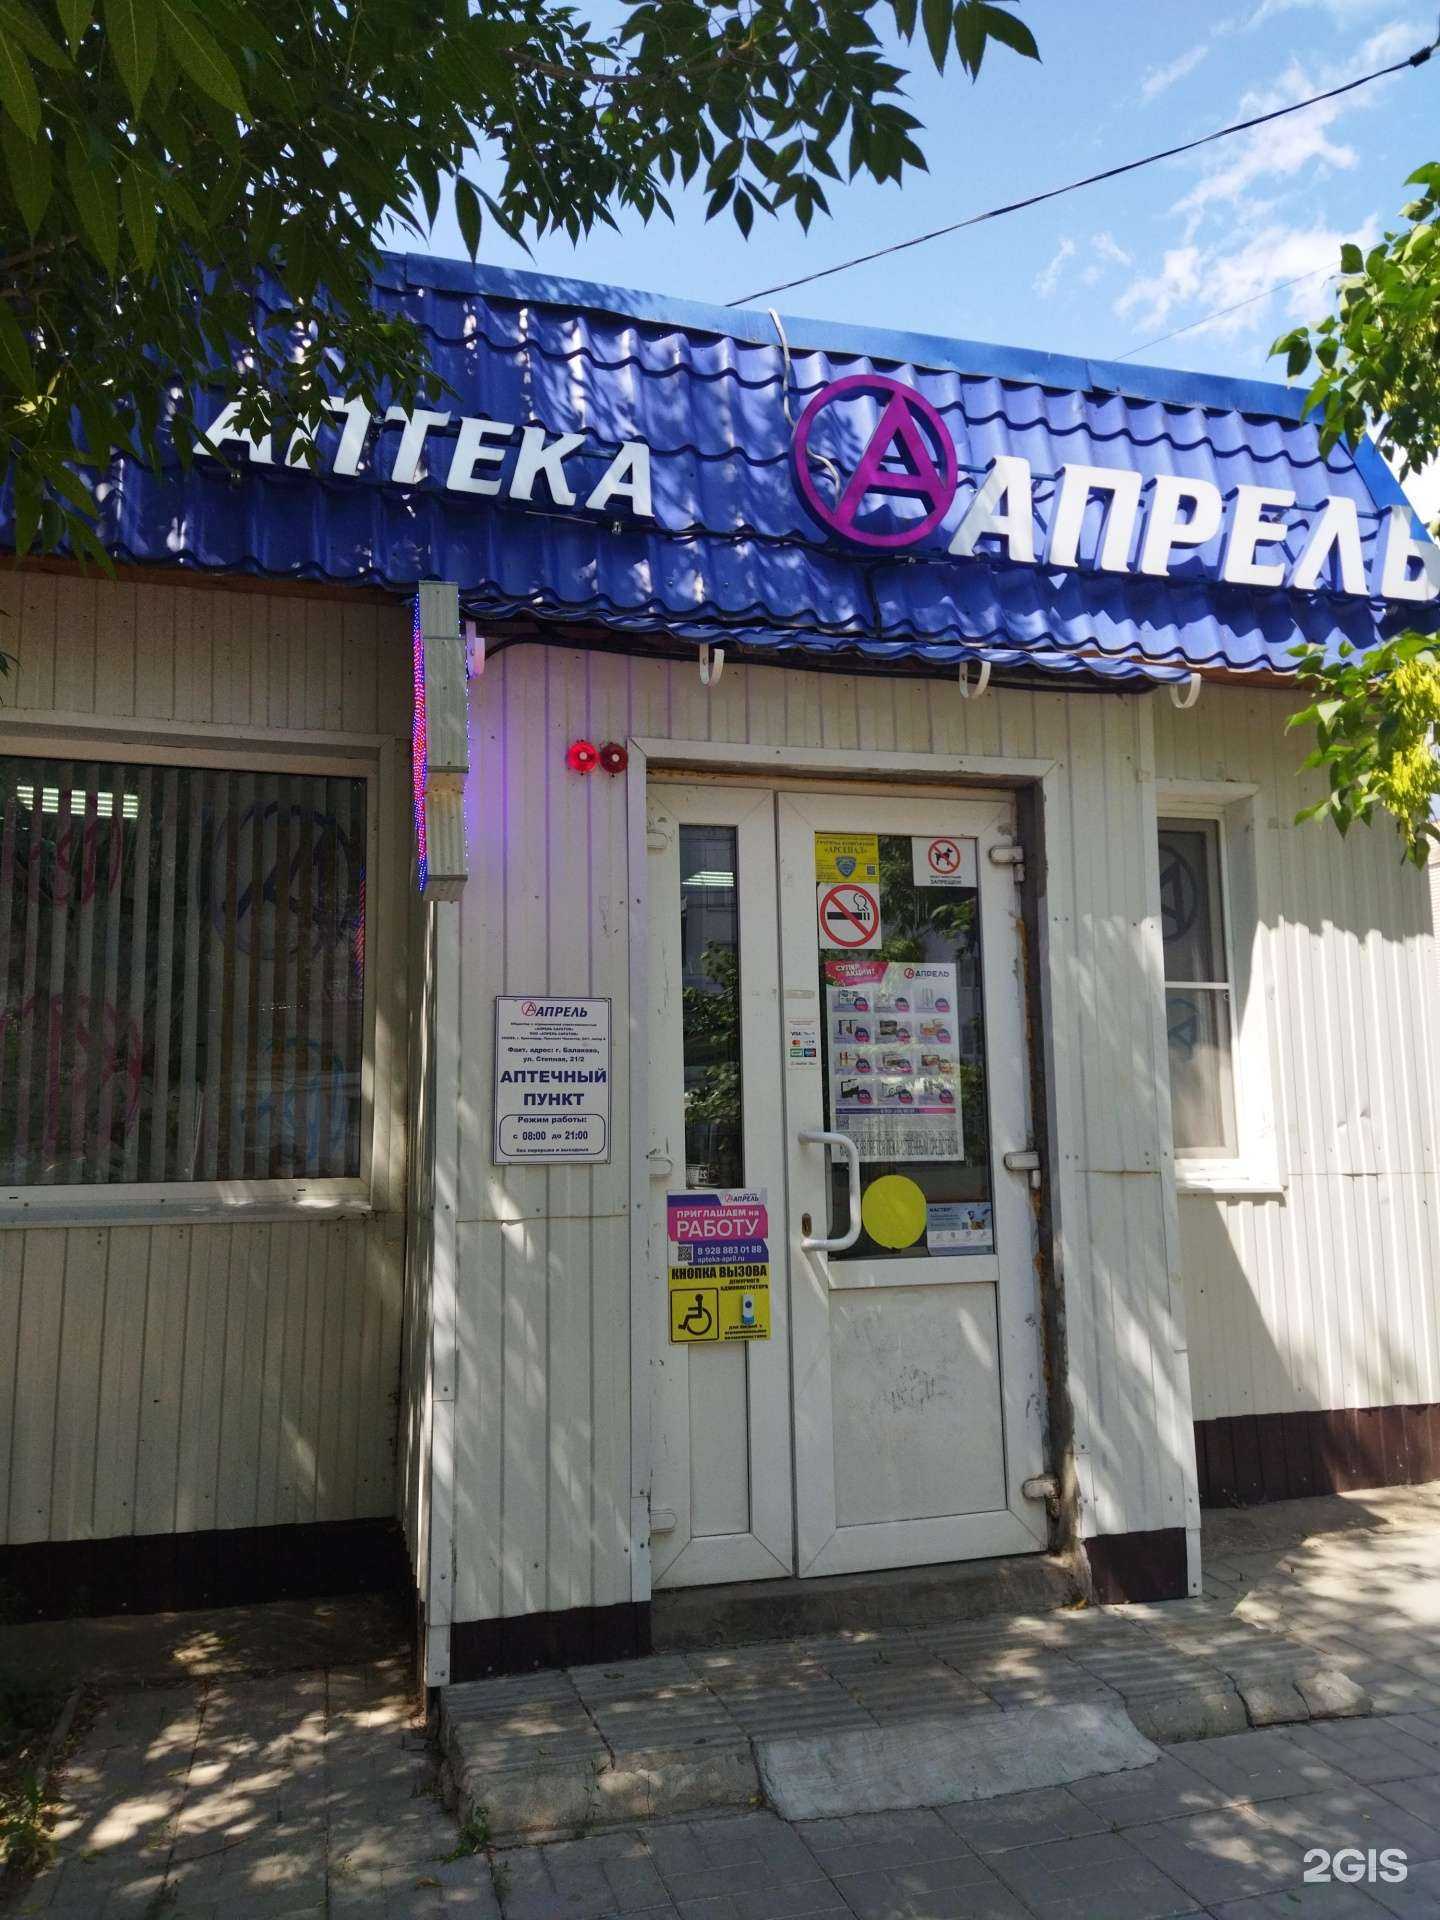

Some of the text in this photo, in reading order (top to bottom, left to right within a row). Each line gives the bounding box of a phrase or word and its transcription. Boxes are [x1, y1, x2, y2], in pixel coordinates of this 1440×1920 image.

[192, 386, 655, 517] АПТЕКА
[948, 456, 1440, 600] АПРЕЛЬ
[536, 1006, 588, 1018] АПРЕЛЬ
[500, 1068, 607, 1083] АПТЕЧНЫЙ
[523, 1093, 585, 1106] ПУНКТ
[551, 1116, 587, 1124] работы:
[522, 1131, 546, 1140] 08:00
[565, 1131, 588, 1140] 21:00
[676, 1208, 746, 1219] ПРИГЛАШАЕМ
[676, 1219, 759, 1237] РАБОТУ
[705, 1247, 721, 1255] 928
[722, 1246, 738, 1254] 883
[740, 1246, 750, 1254] 01
[751, 1245, 762, 1253] 88
[671, 1265, 767, 1280] КНОПКА ВЫЗОВА
